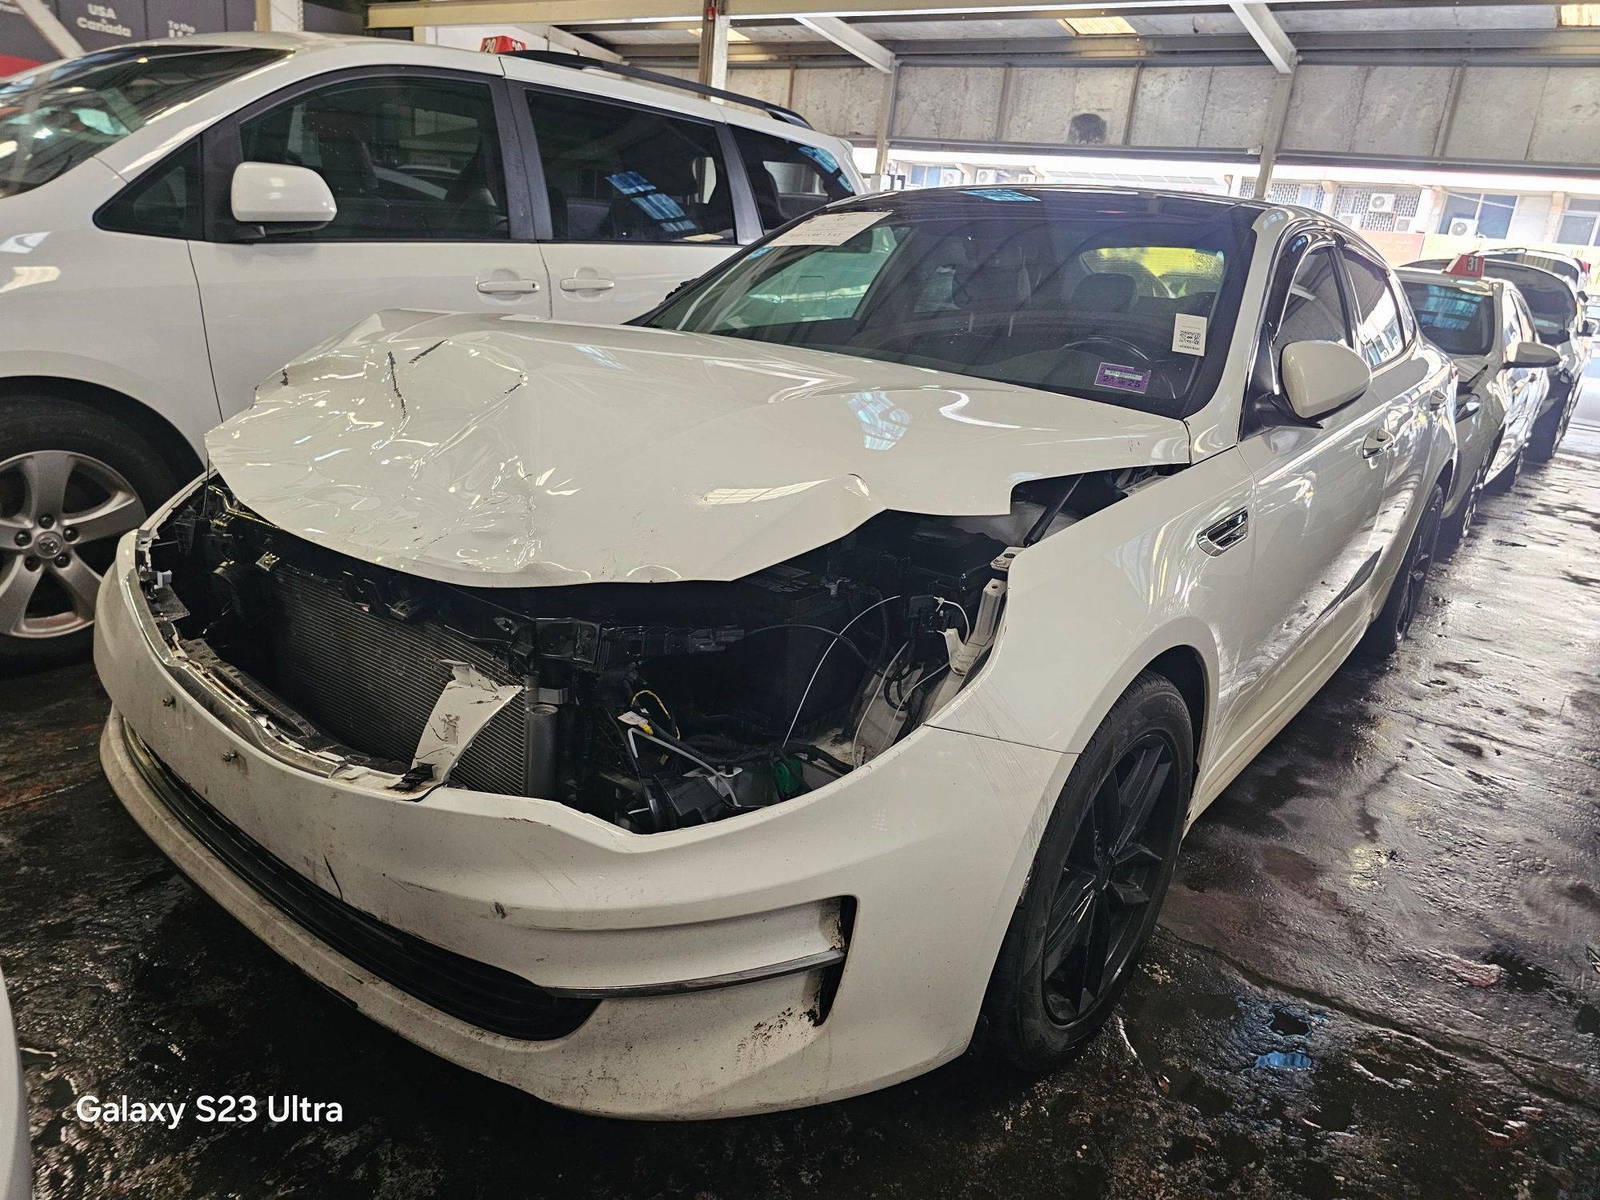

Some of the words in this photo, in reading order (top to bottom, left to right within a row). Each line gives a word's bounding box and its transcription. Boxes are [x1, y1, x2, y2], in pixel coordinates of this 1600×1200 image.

[87, 3, 117, 19] USA
[77, 16, 132, 37] Canada
[1467, 256, 1479, 272] 31
